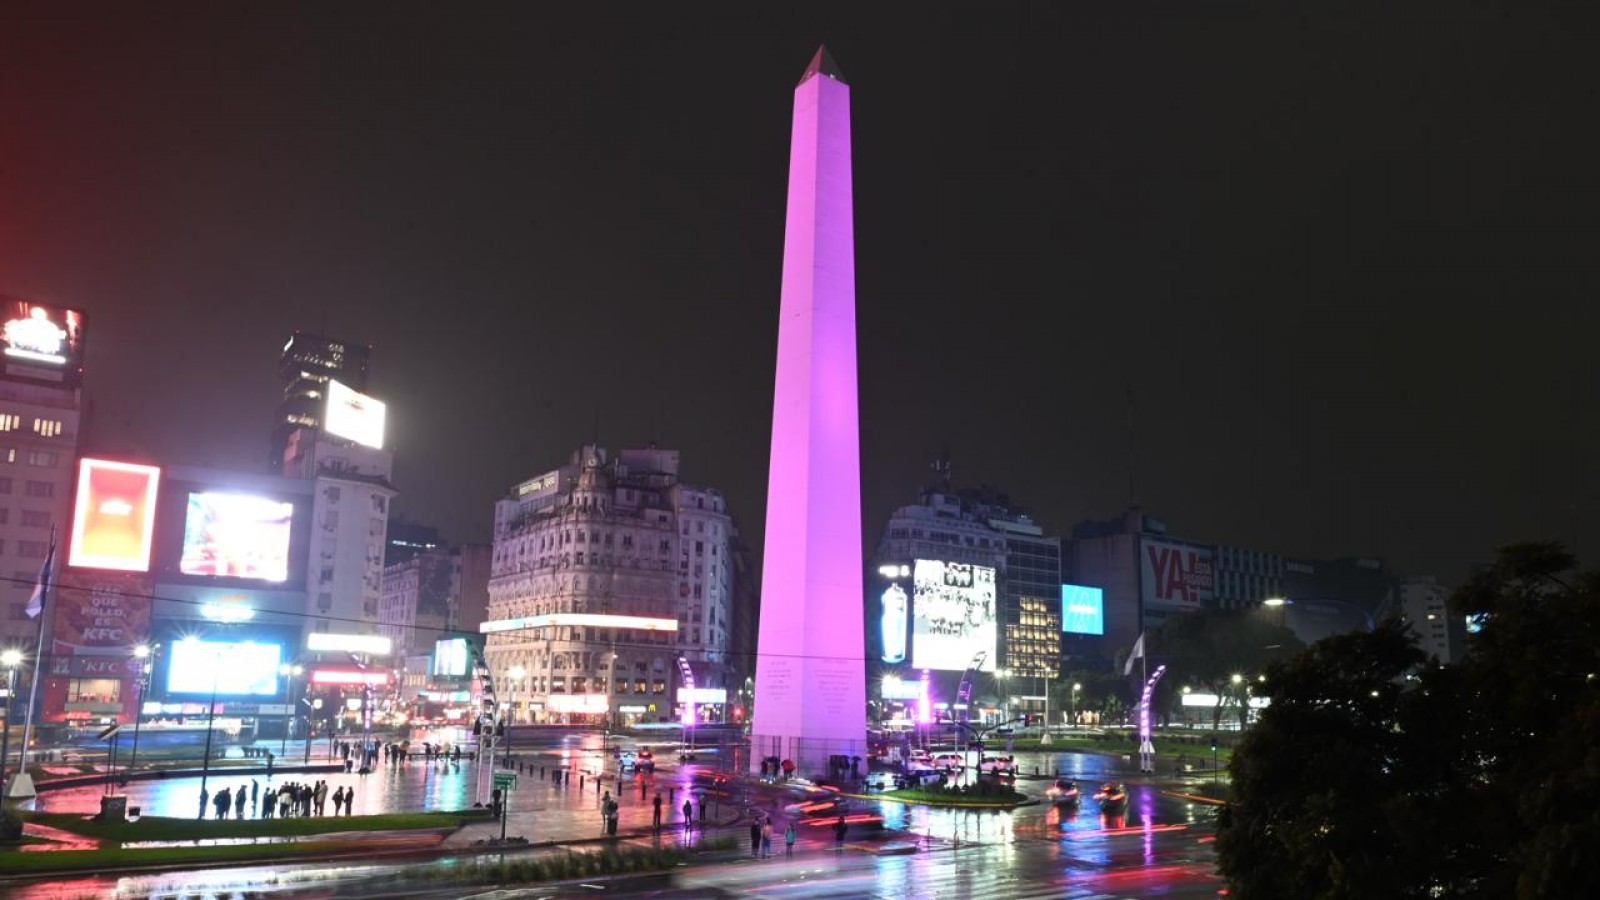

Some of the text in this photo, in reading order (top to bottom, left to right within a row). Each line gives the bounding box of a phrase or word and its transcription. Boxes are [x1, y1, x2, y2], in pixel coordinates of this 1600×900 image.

[1147, 545, 1198, 602] YA!
[92, 598, 118, 607] QUE
[83, 628, 123, 641] KFC
[86, 662, 119, 672] KFC
